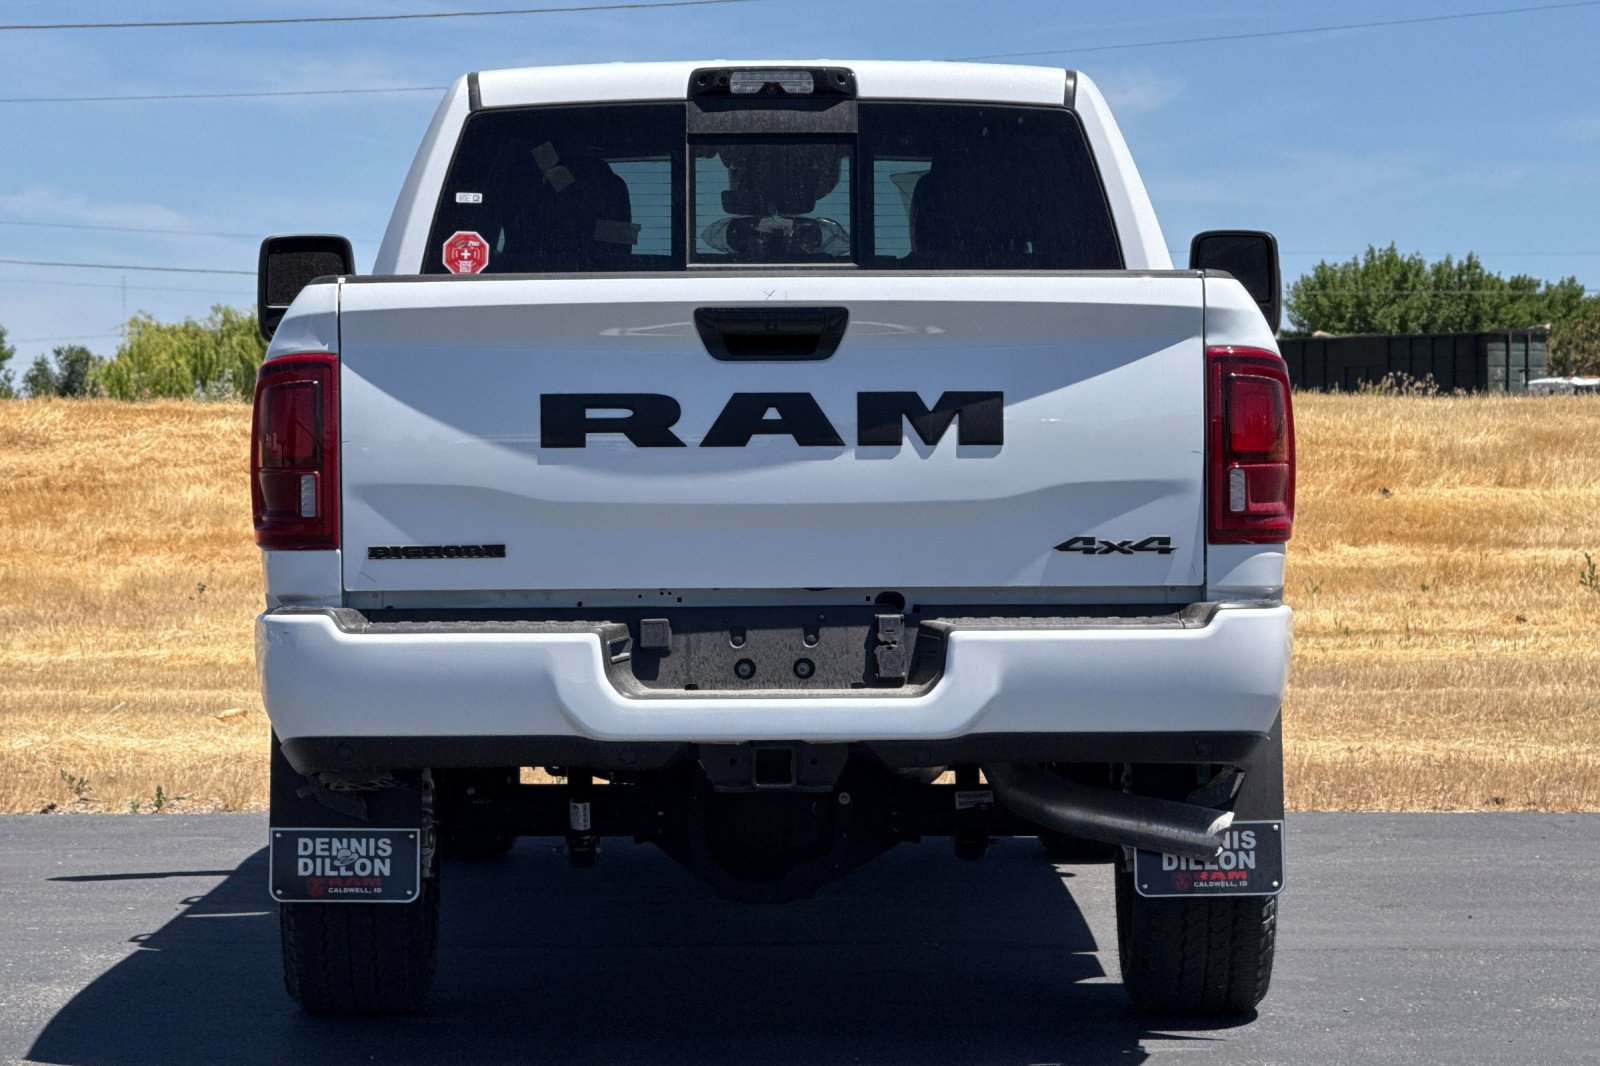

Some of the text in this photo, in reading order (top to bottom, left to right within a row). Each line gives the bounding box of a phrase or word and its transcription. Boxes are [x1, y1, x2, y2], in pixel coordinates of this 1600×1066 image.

[540, 391, 1004, 448] RAM
[1052, 536, 1178, 554] 4x4
[297, 837, 392, 857] DENNIS
[297, 858, 391, 876] DILLON
